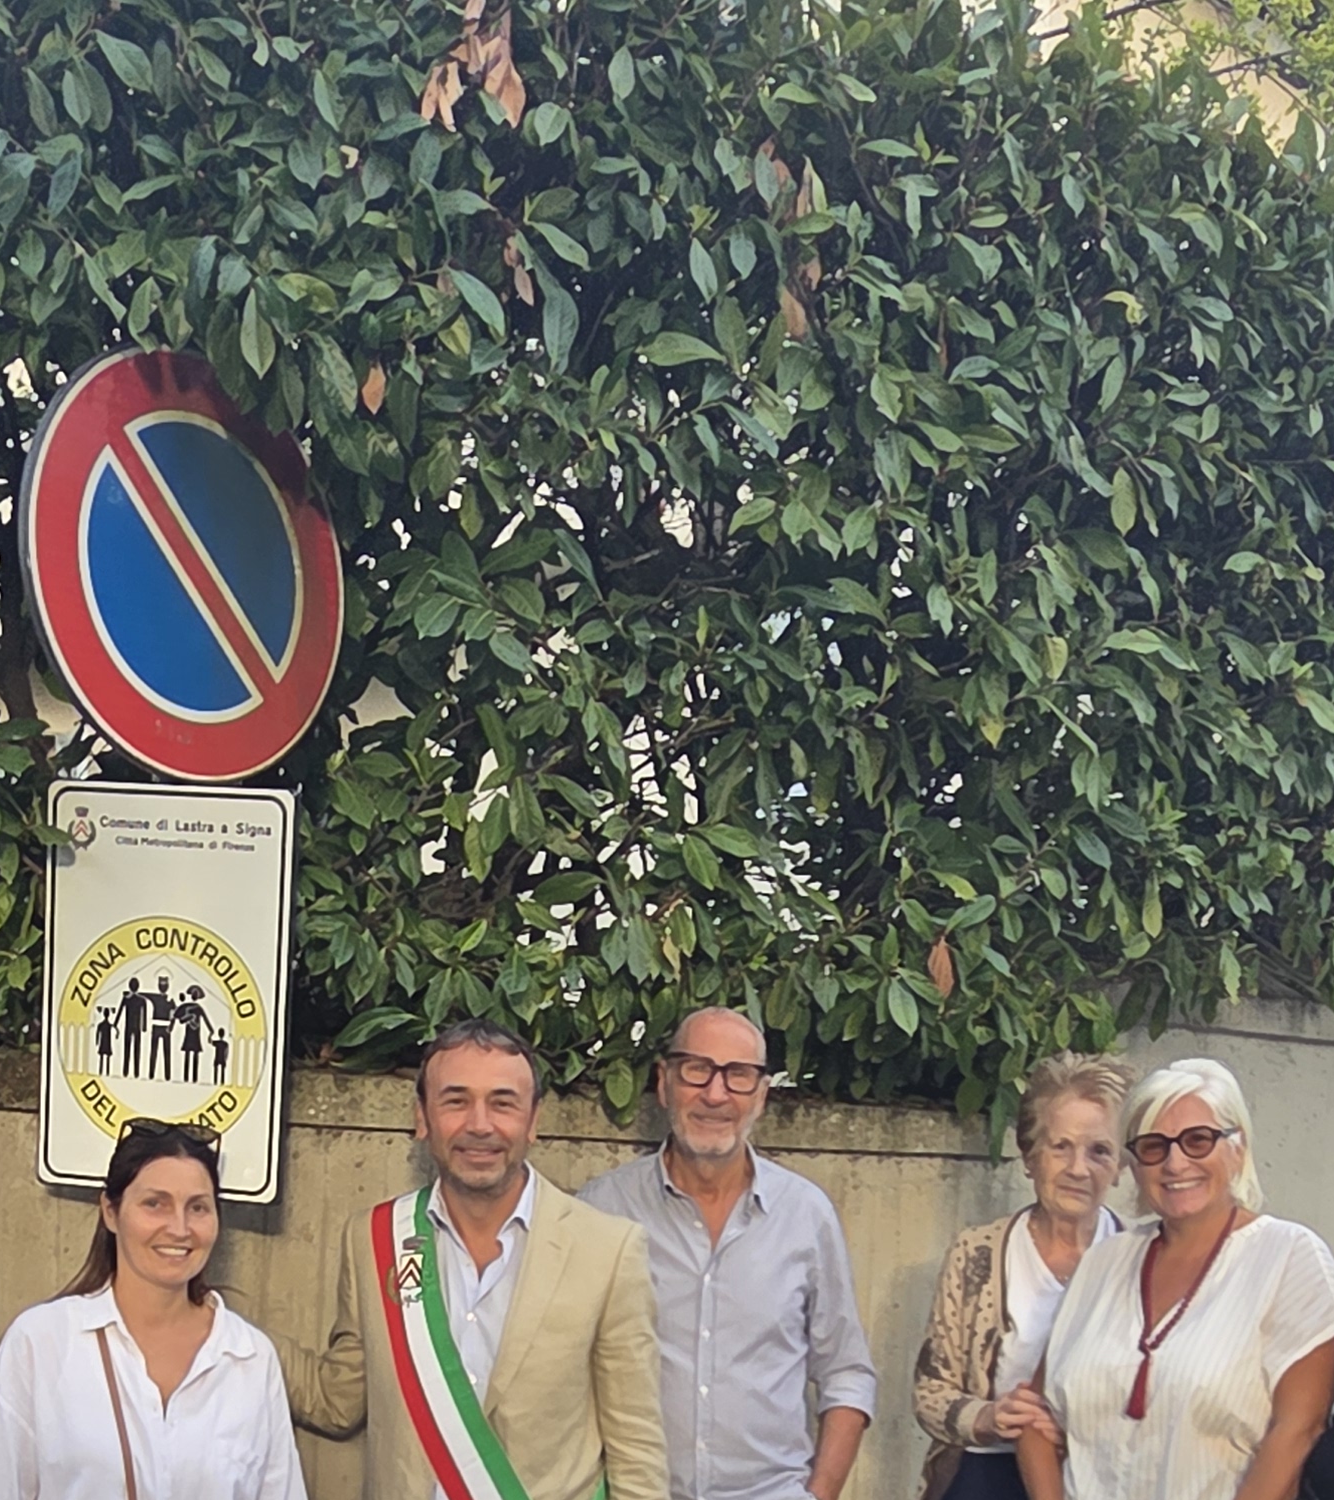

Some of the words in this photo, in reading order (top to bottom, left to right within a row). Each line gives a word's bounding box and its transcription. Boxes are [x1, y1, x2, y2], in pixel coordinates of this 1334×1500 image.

[99, 815, 150, 830] Comune
[156, 818, 168, 831] di
[175, 820, 214, 833] Lastra
[221, 824, 228, 834] a
[235, 822, 272, 837] Signa
[140, 837, 204, 849] Metropolitana
[222, 841, 255, 852] Firenze
[70, 942, 126, 1008] ZONA
[135, 926, 257, 1019] CONTROLLO
[80, 1079, 117, 1128] DEL
